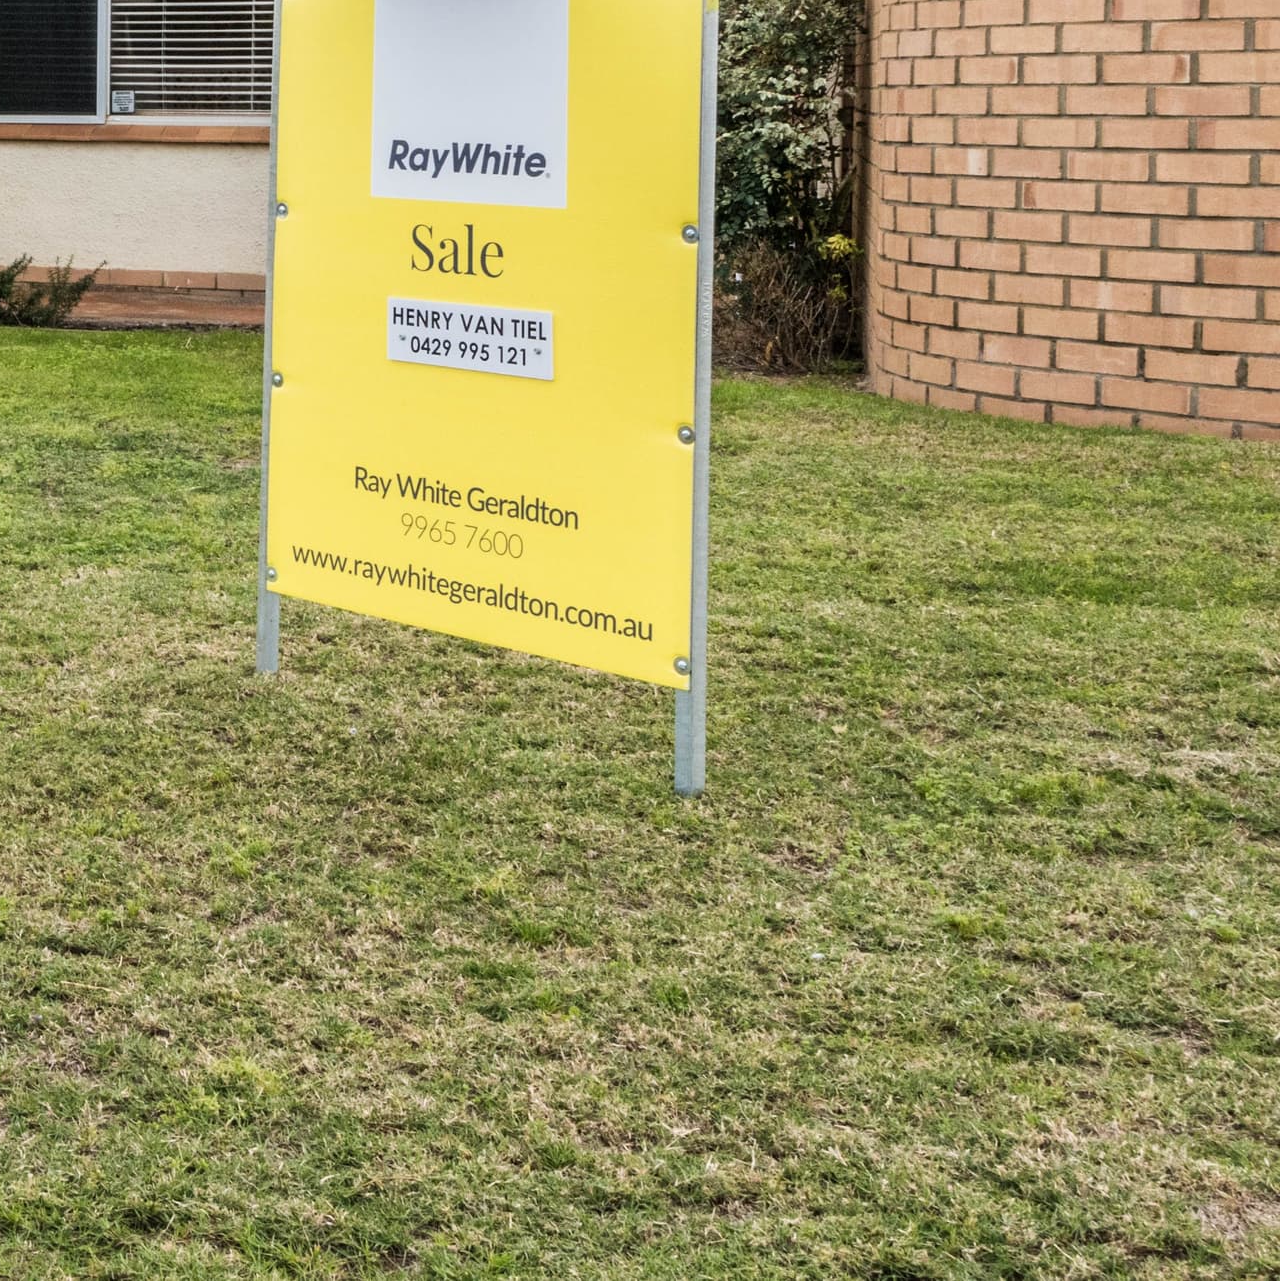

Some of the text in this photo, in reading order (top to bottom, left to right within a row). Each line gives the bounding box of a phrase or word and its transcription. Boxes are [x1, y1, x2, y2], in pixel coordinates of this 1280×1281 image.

[410, 223, 504, 278] Sale
[392, 306, 547, 341] HENRY VAN TIEL
[410, 335, 527, 367] 0429 995 121
[354, 466, 579, 530] Ray White Geraldton
[400, 512, 524, 559] 9965 7600
[291, 545, 653, 642] www.raywhitegeraldton.com.au
